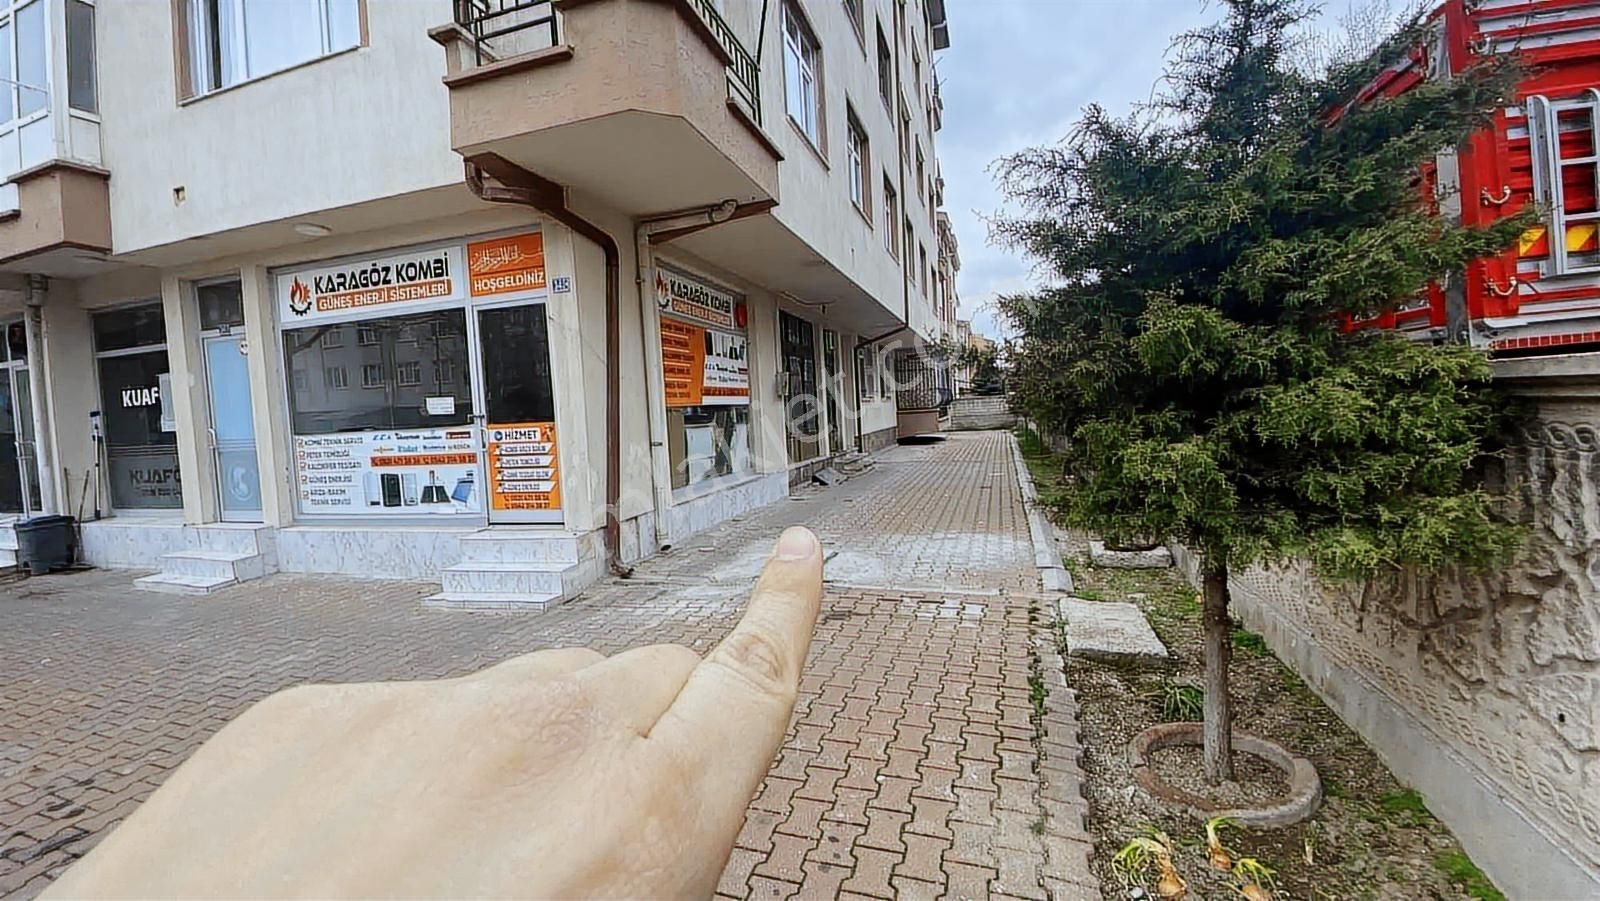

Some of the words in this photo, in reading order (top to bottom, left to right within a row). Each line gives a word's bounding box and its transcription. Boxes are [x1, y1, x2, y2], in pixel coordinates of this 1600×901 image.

[314, 263, 392, 295] KARAGÖZ
[396, 252, 449, 285] KOMBİ
[474, 270, 545, 291] HOŞGELDİNİZ
[318, 294, 352, 310] GÜNEŞ
[354, 288, 388, 306] ENERJİ
[390, 280, 449, 302] SİSTEMLERİ
[505, 428, 538, 440] HİZMET
